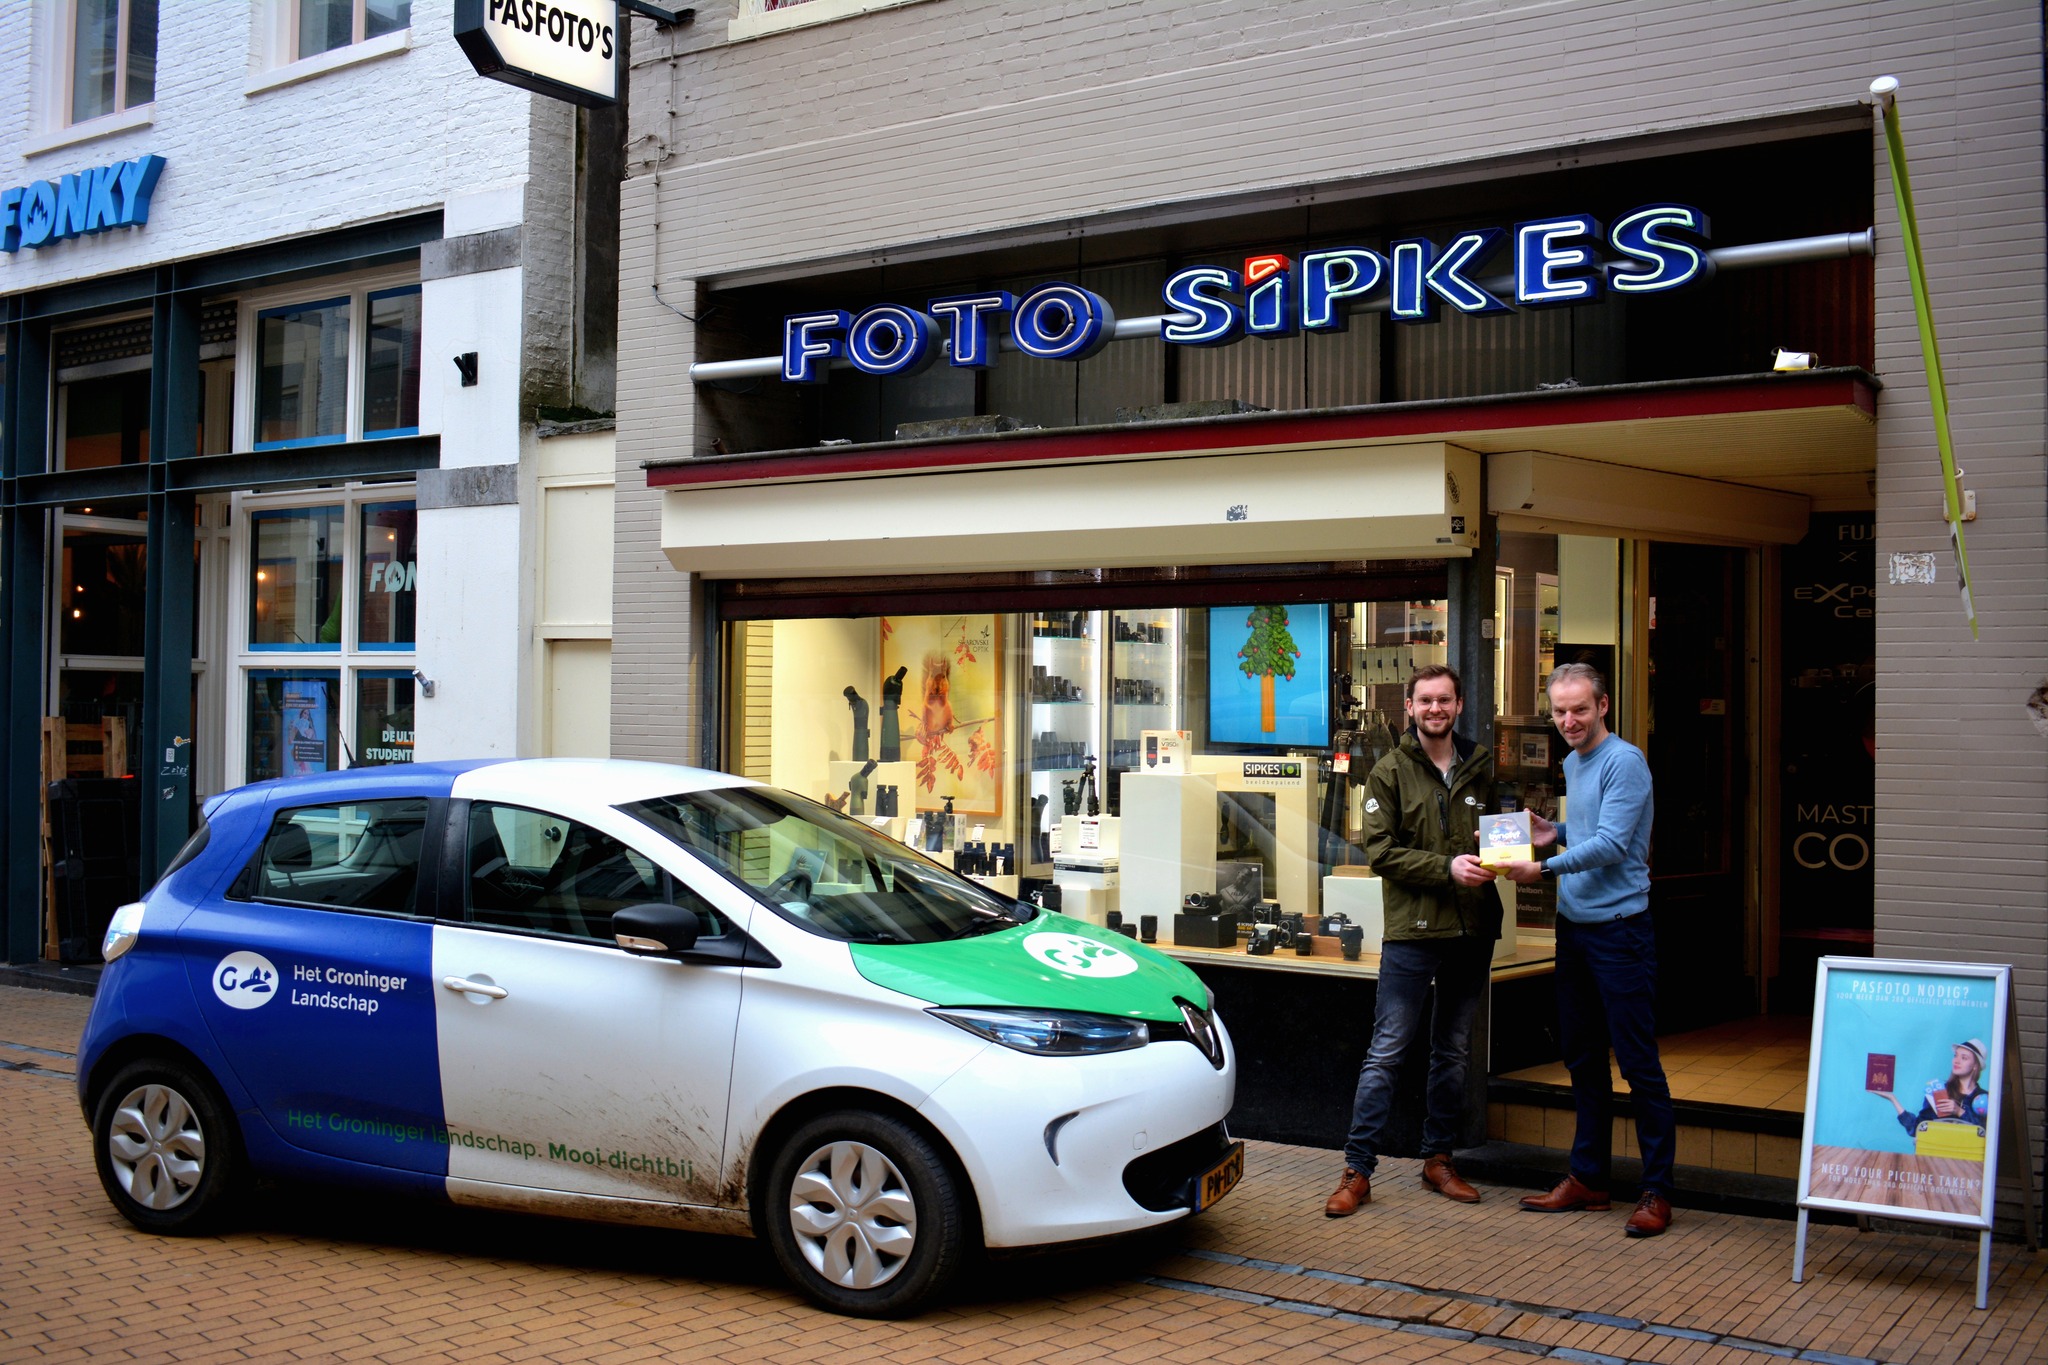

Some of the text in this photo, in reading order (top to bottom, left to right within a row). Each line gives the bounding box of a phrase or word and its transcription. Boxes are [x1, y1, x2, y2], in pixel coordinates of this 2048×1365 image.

[489, 0, 613, 60] PASFOTO'S
[0, 154, 162, 252] FONKY
[781, 281, 1108, 382] FOTO
[382, 731, 395, 743] DE
[1245, 764, 1280, 775] SIPKES
[1793, 832, 1869, 871] CO
[293, 965, 408, 993] Het Groninger
[1852, 980, 1970, 999] PASFOTO NODIG?
[291, 989, 379, 1016] Landschap
[288, 1110, 693, 1184] Het Groninger landschap. Mooi dichtbij
[1821, 1163, 1982, 1190] NEED YOUR PICTURE TAKEN?
